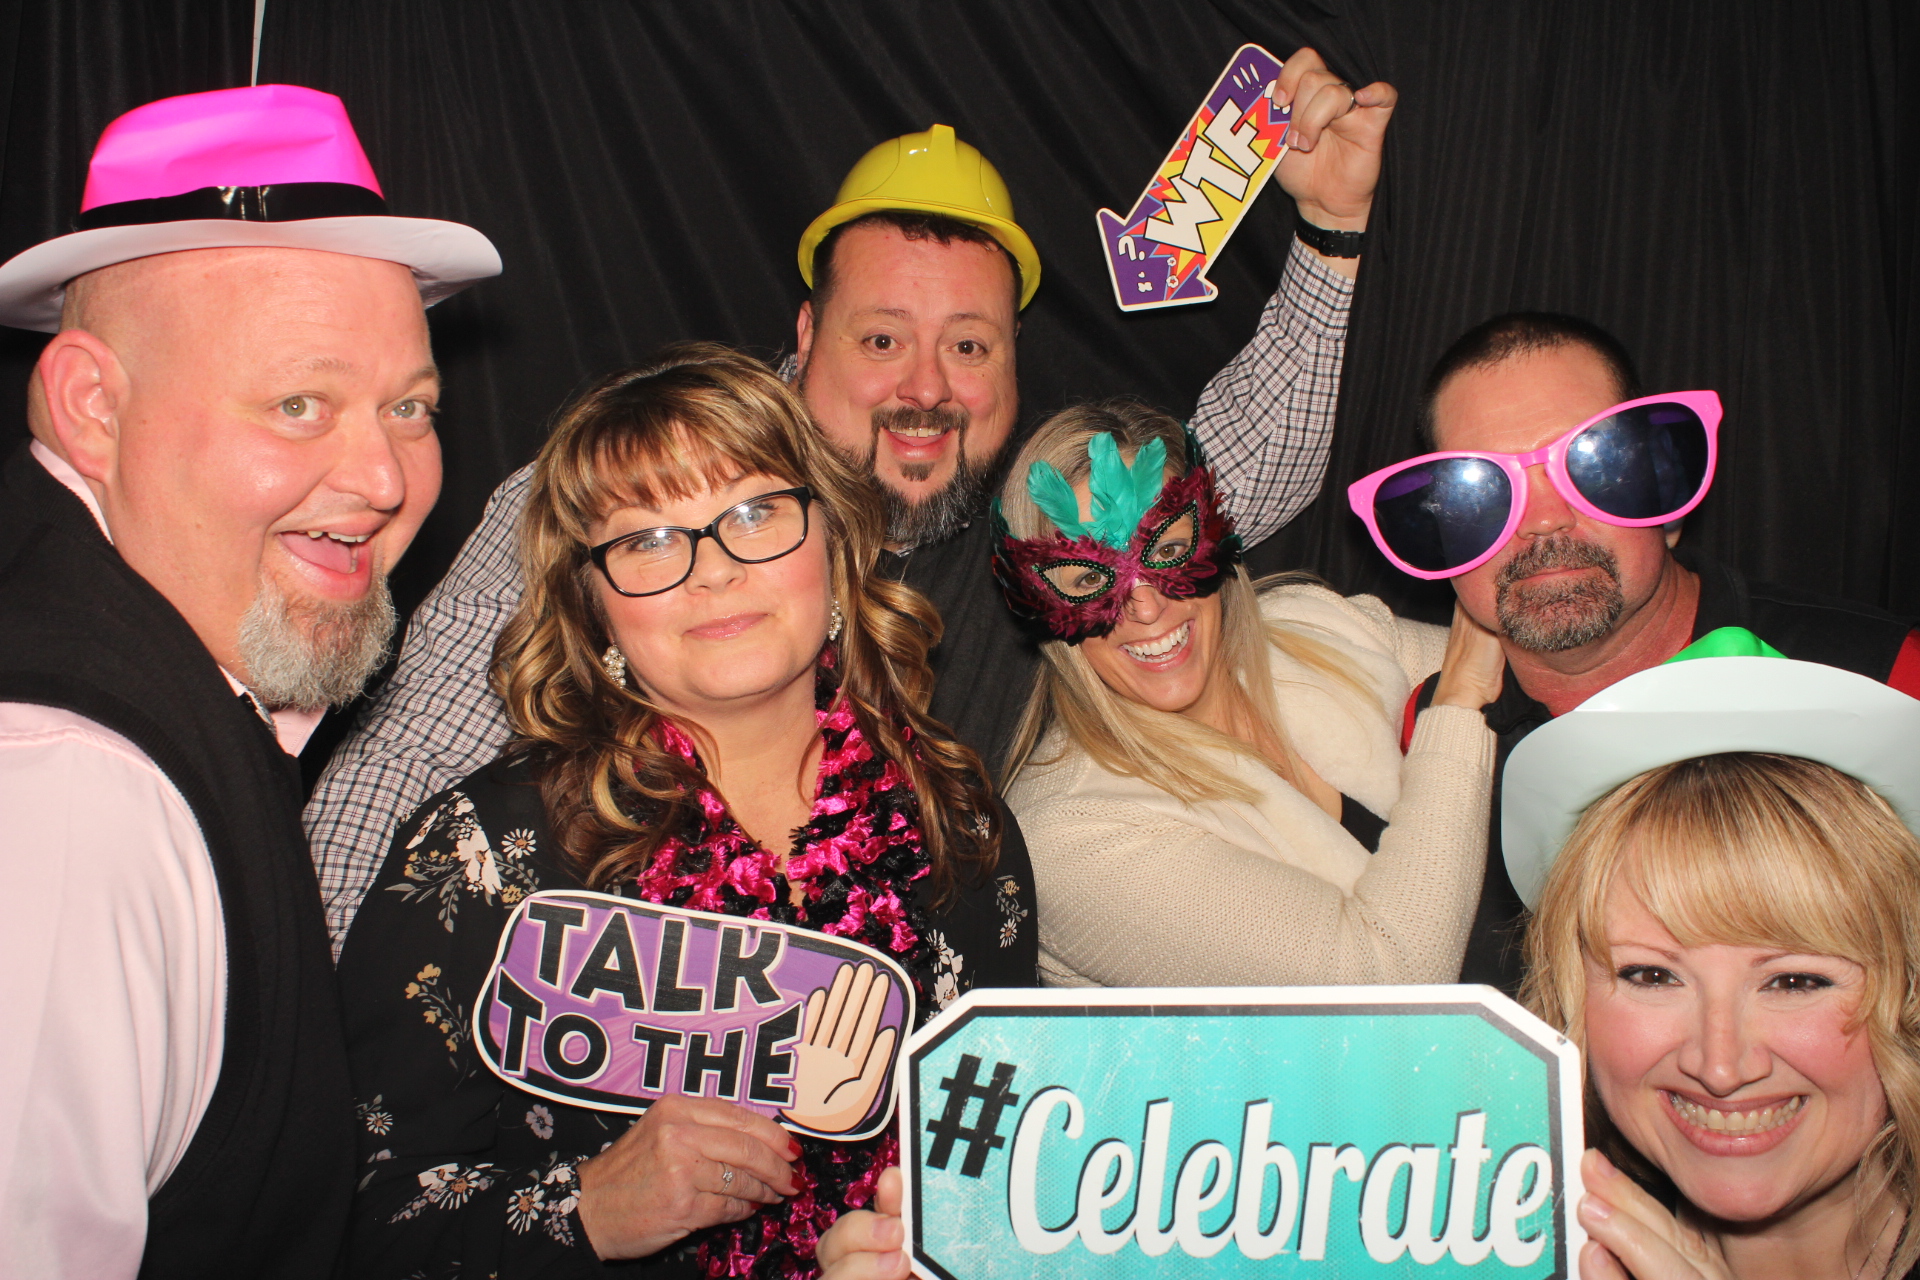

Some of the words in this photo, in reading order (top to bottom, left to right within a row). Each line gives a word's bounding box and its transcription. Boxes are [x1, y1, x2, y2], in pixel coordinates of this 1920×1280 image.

[1143, 96, 1264, 255] WTF
[525, 899, 786, 1014] TALK
[497, 966, 611, 1083] TO
[632, 1002, 803, 1108] THE
[925, 1053, 1553, 1268] #Celebrate
